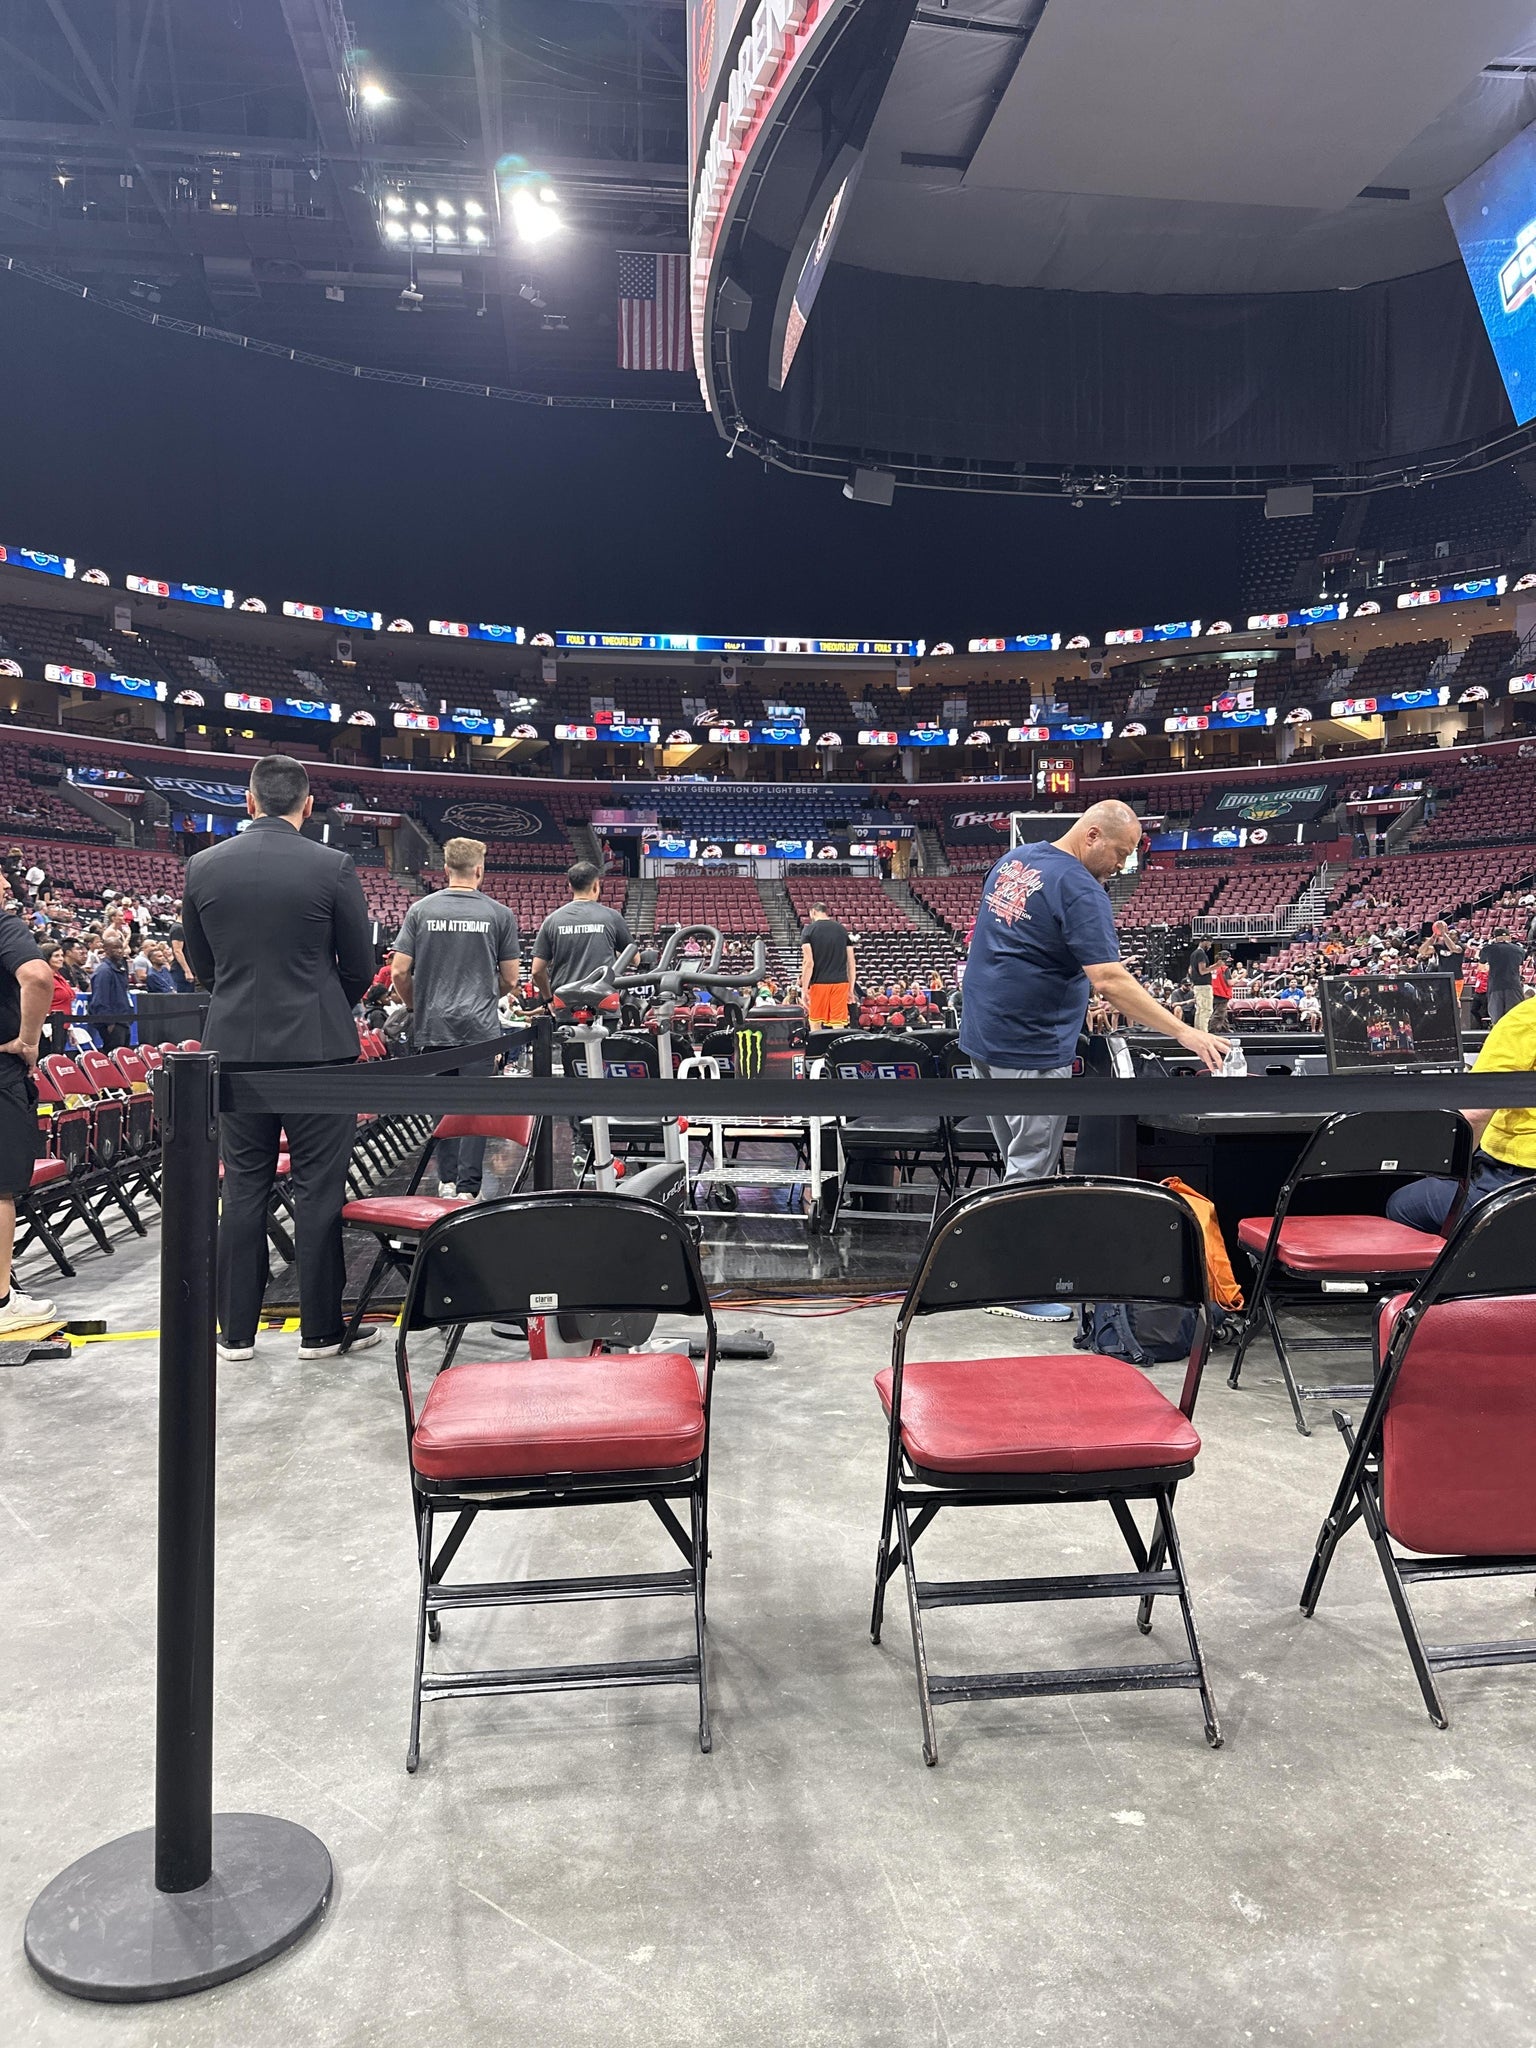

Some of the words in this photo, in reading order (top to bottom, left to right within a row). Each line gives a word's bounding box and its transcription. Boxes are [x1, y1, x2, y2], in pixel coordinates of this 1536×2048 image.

[566, 635, 585, 645] FOULS
[602, 636, 629, 646] TIMEOUTS
[629, 637, 643, 647] LEFT
[820, 642, 846, 652] TIMEOUTS
[846, 643, 858, 652] LEFT
[874, 643, 892, 653] FOULS
[153, 779, 247, 796] POWE
[1051, 772, 1070, 792] 14
[124, 793, 140, 804] 107
[426, 920, 447, 932] TEAM
[448, 920, 490, 933] ATTENDANT
[558, 925, 574, 935] TEAM
[574, 924, 605, 935] ATTENDANT
[535, 1295, 553, 1303] clarin
